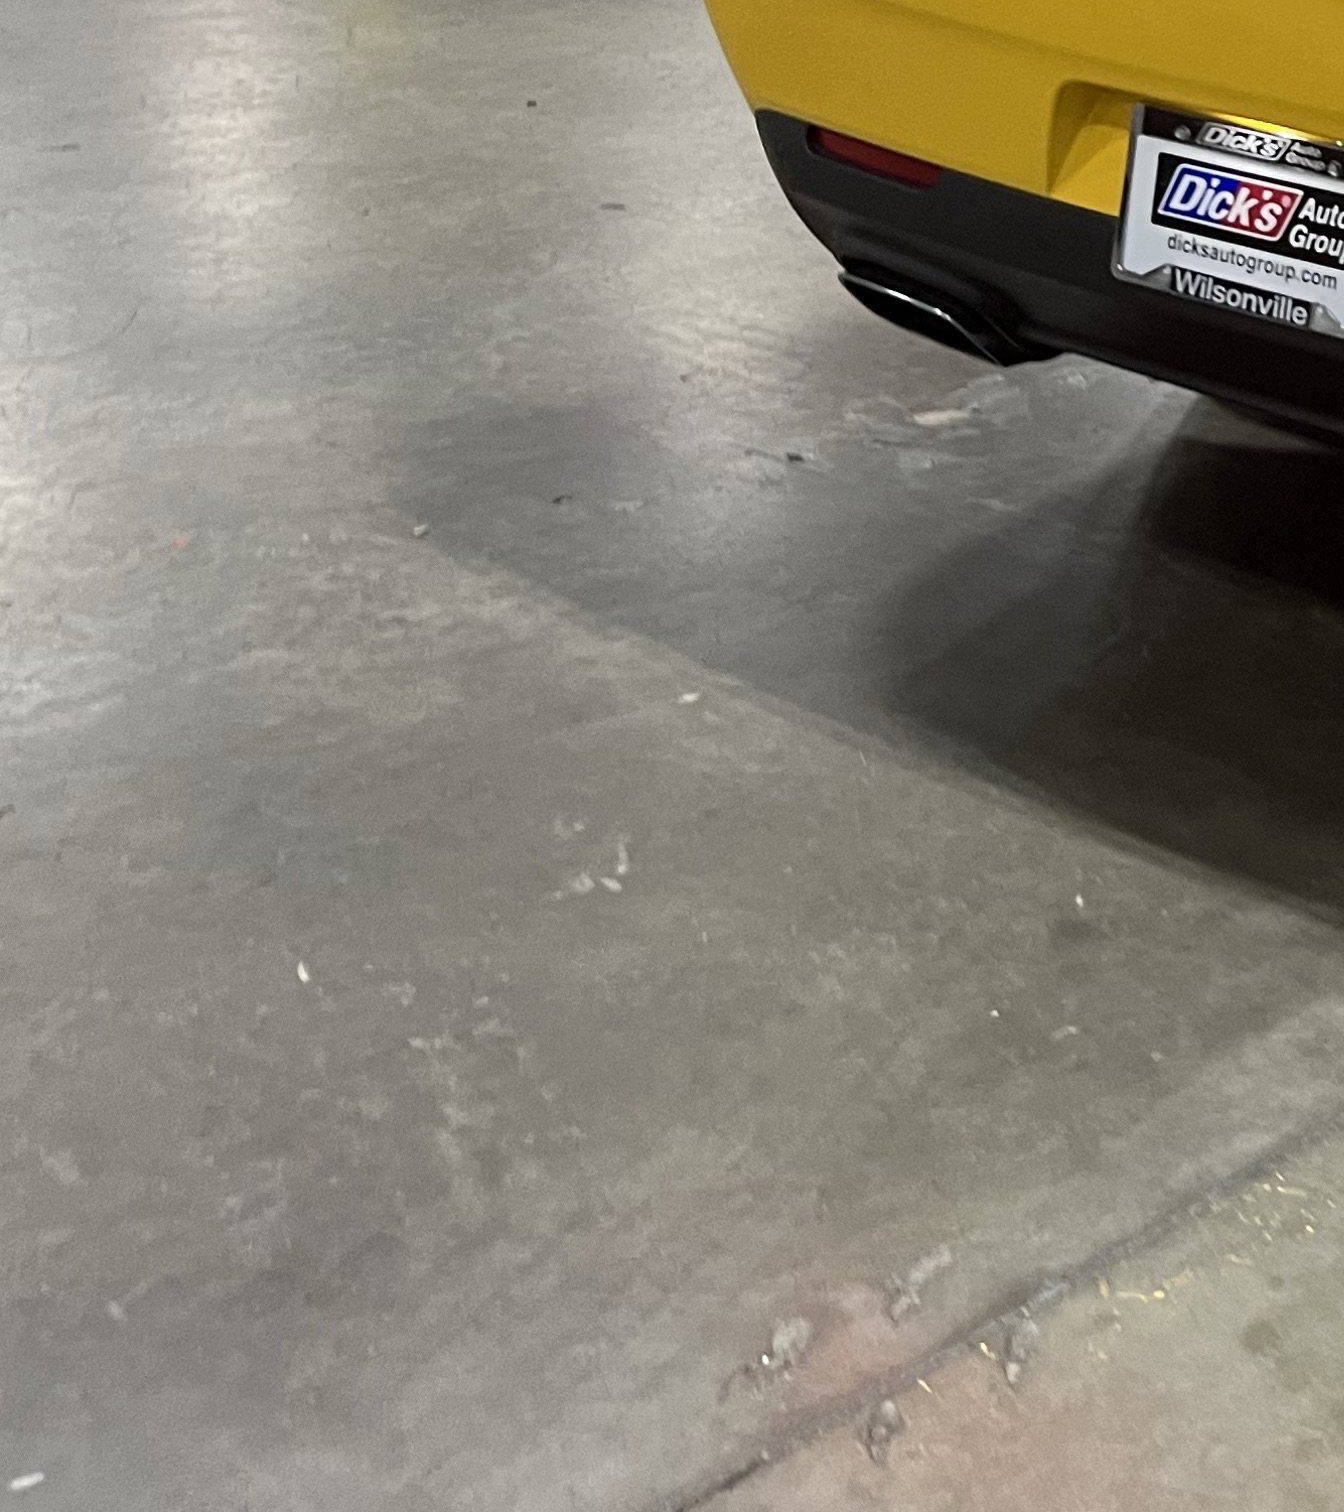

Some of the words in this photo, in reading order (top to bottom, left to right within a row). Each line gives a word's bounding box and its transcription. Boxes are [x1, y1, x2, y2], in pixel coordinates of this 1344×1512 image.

[1167, 173, 1284, 233] Dick's
[1167, 234, 1338, 289] dicksautogroup.com
[1174, 266, 1309, 325] Wilsonville
